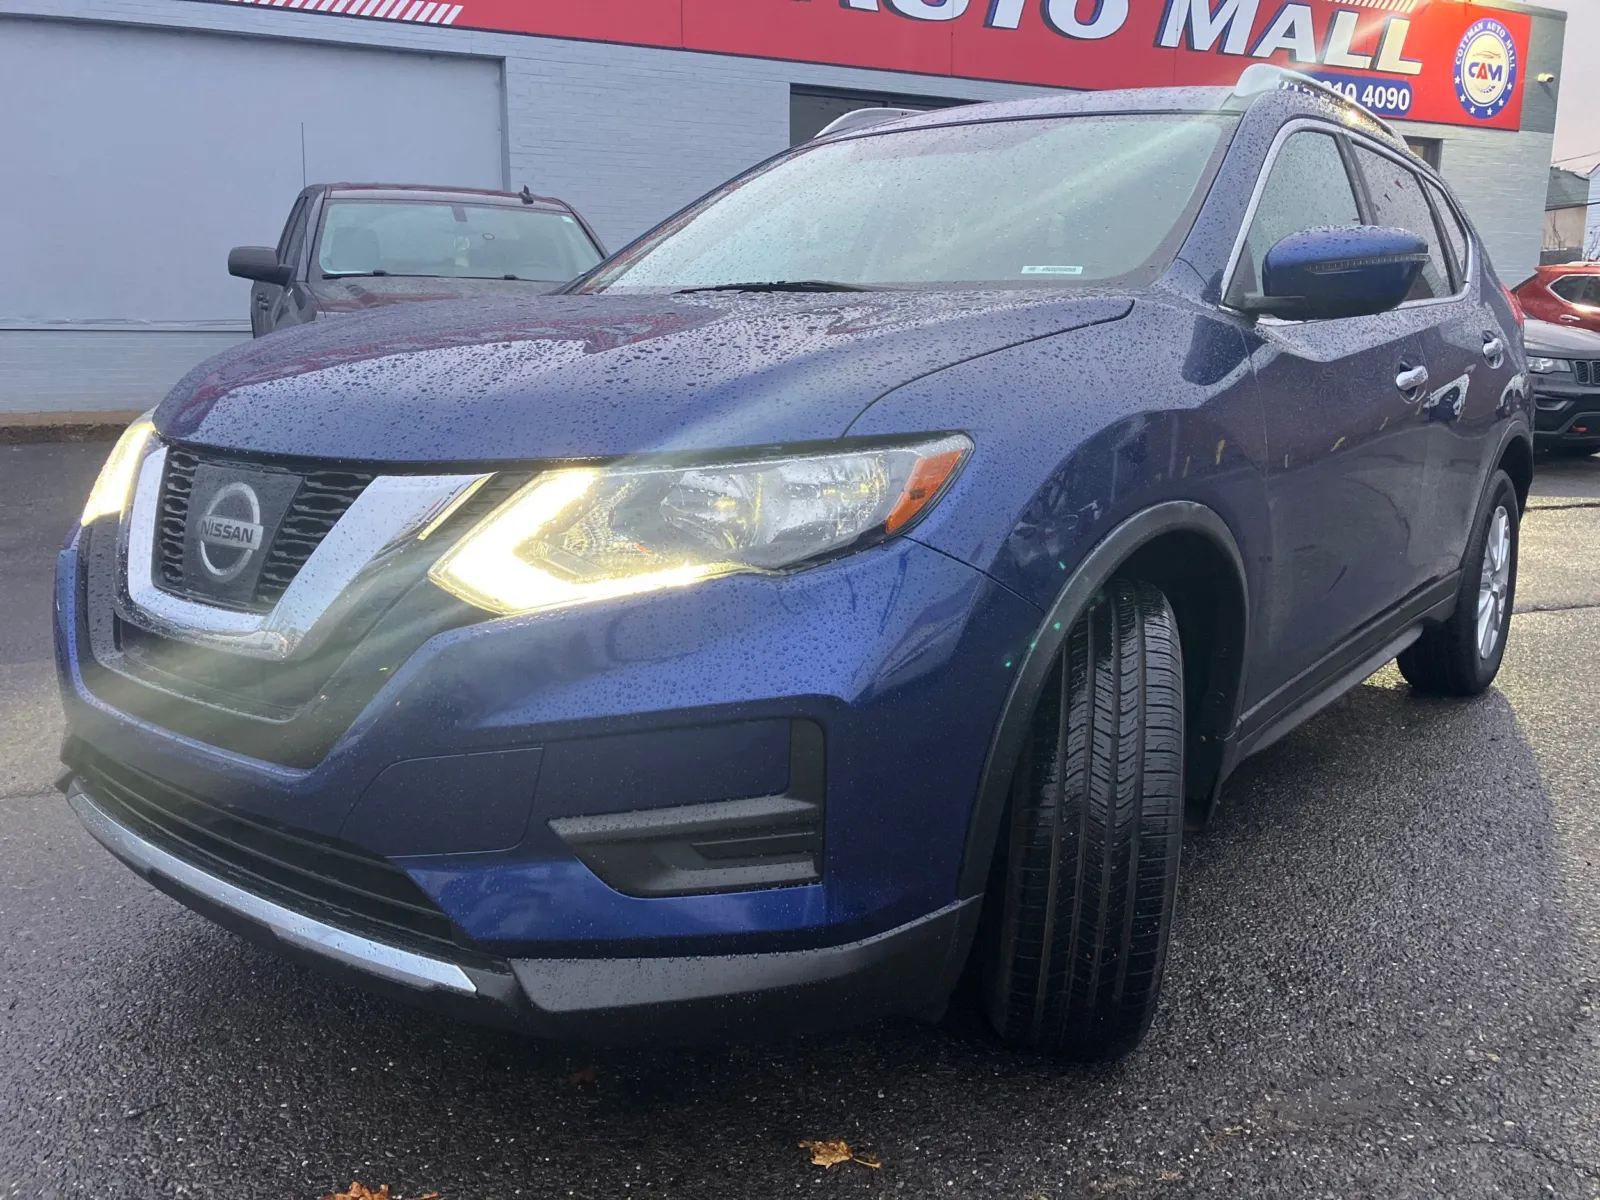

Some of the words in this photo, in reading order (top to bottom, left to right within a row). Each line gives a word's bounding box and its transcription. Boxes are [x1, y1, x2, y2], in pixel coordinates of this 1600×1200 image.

[1156, 0, 1423, 75] MALL
[1455, 21, 1484, 65] COTTMAN
[1486, 21, 1506, 38] AUTO
[1505, 39, 1516, 71] MALL
[1468, 61, 1503, 81] CAM
[1361, 84, 1410, 111] 4090
[200, 519, 255, 544] NISSAN
